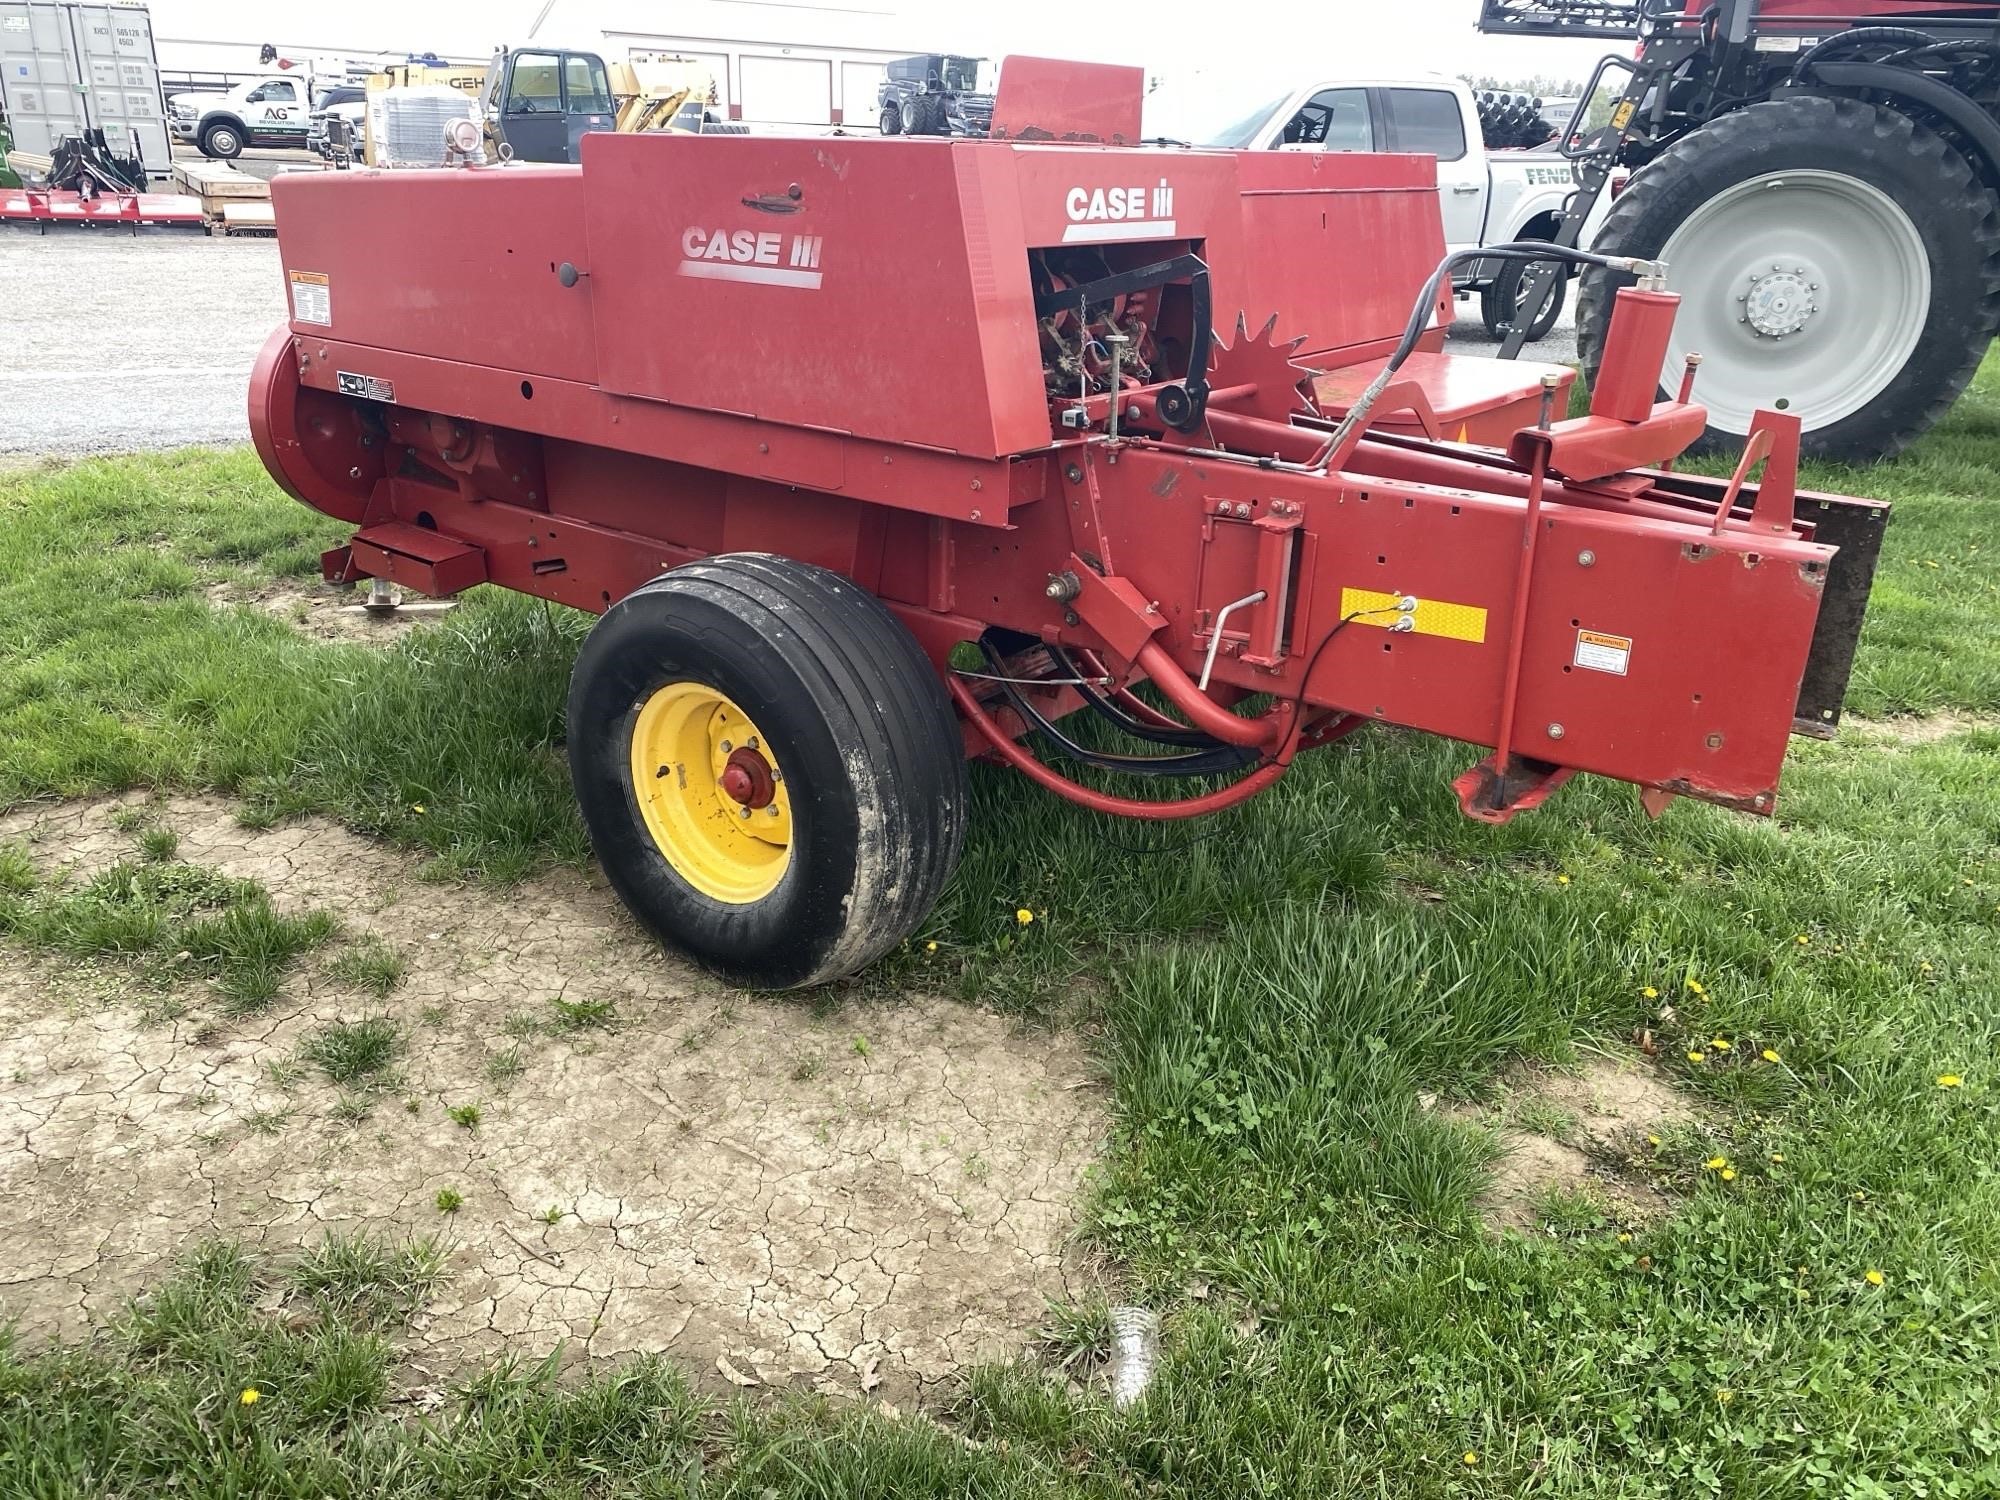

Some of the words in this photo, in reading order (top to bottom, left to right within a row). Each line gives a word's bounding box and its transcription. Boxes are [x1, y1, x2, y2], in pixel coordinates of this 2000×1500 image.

[449, 77, 485, 89] GEH
[264, 107, 288, 120] AG
[1525, 168, 1571, 185] FEND
[1066, 187, 1146, 221] CASE
[681, 226, 782, 264] CASE
[1594, 637, 1624, 647] WARNING
